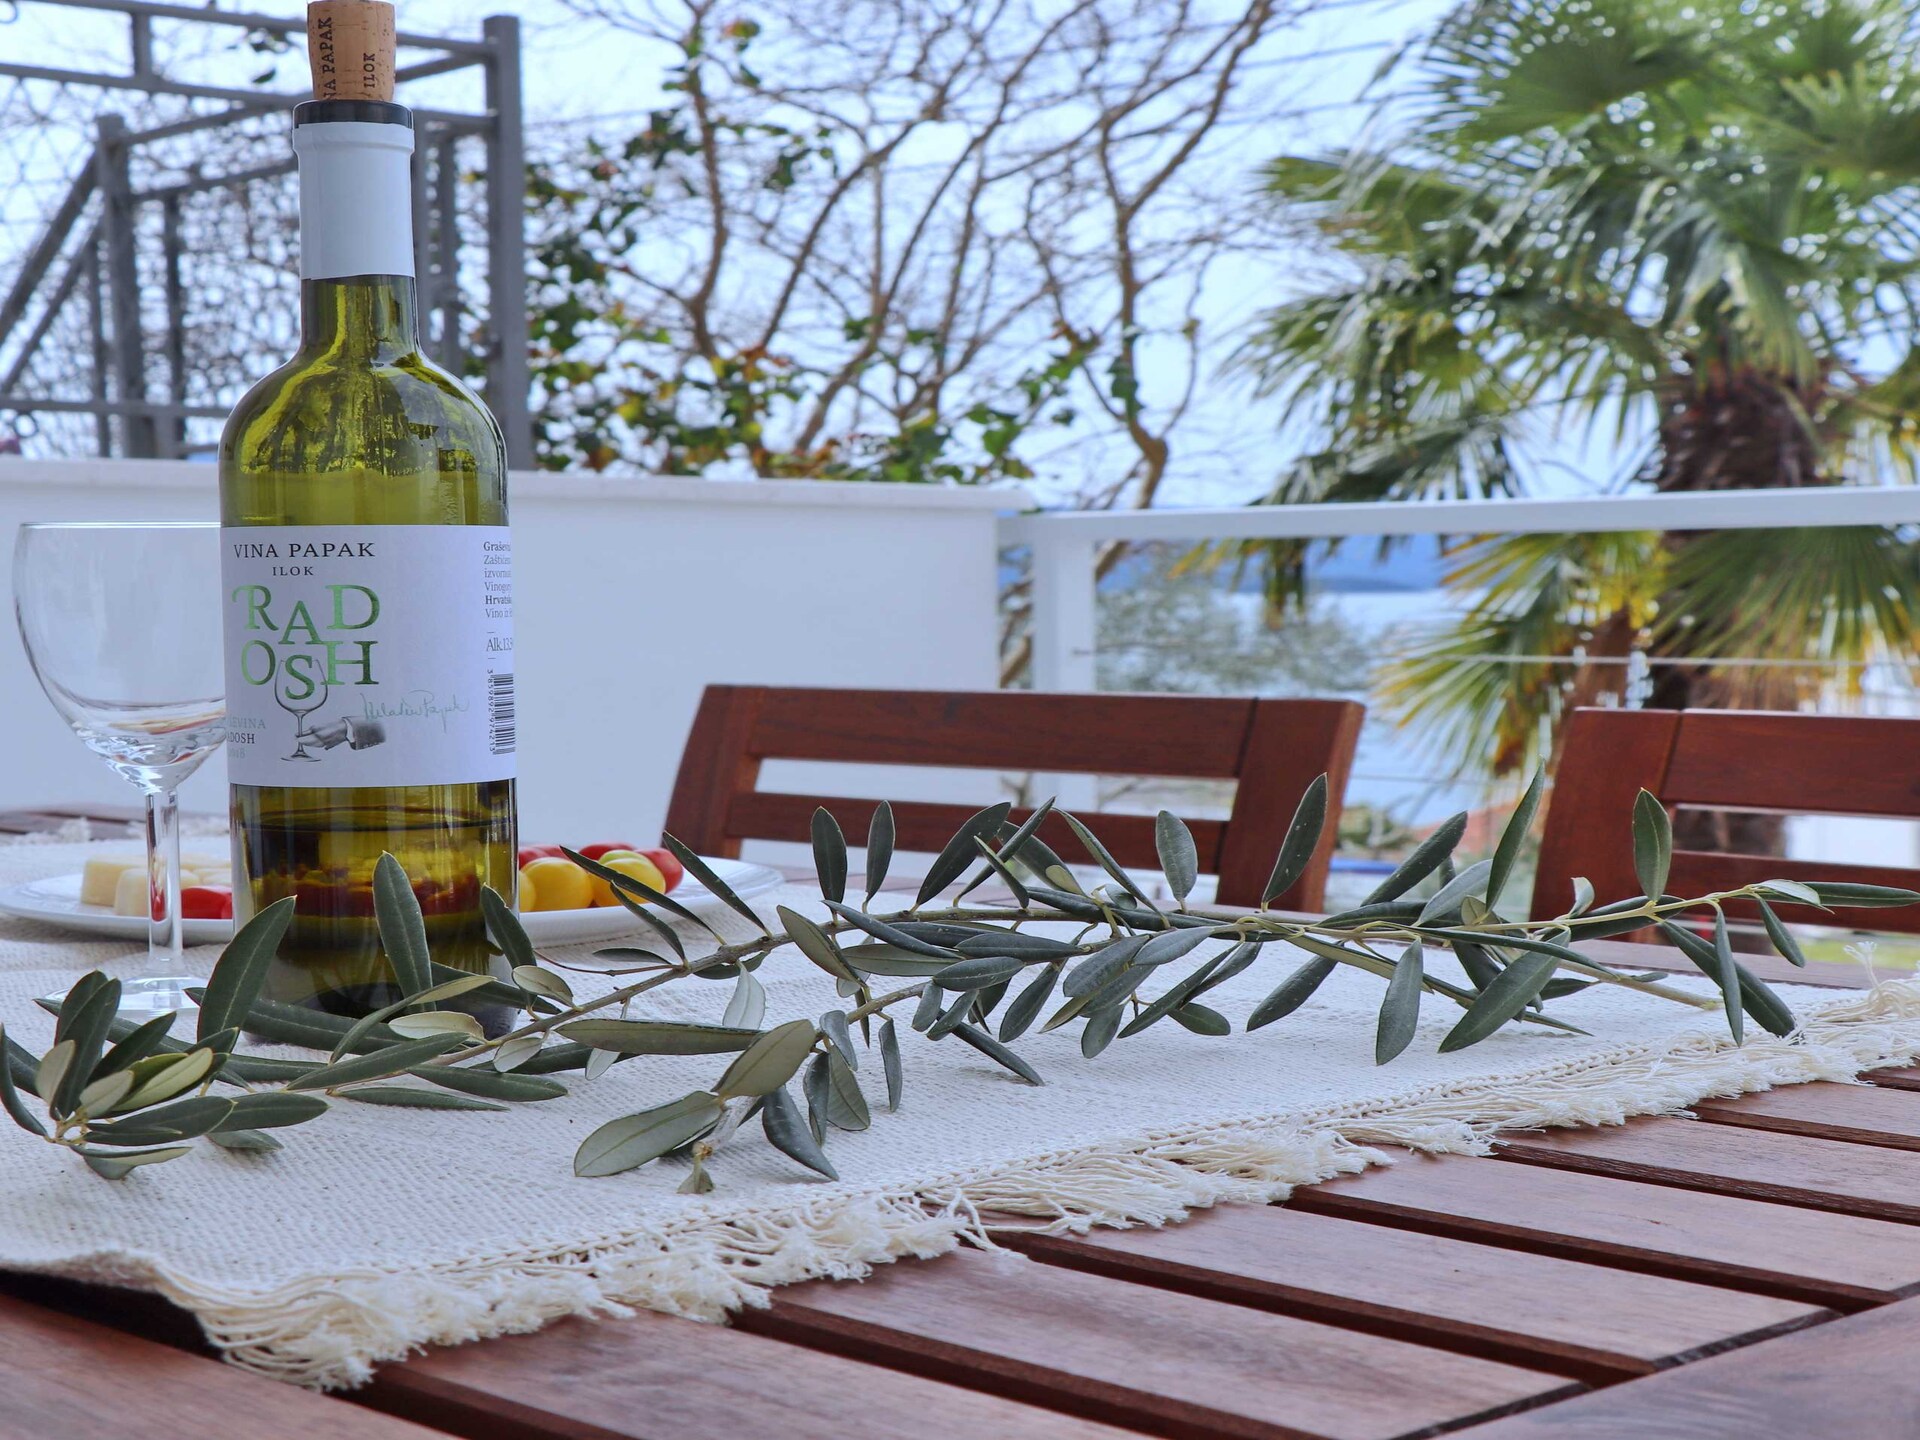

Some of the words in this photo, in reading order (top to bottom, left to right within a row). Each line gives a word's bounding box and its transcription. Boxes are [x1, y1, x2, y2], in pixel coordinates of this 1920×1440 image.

[318, 17, 335, 74] PAPAK
[363, 52, 376, 88] ILOK
[233, 543, 279, 558] VINA
[288, 541, 375, 558] PAPAK
[272, 566, 314, 576] ILOK
[231, 584, 380, 645] RAD
[485, 608, 503, 618] Vino
[241, 640, 380, 700] OSH
[230, 716, 266, 730] EVINA
